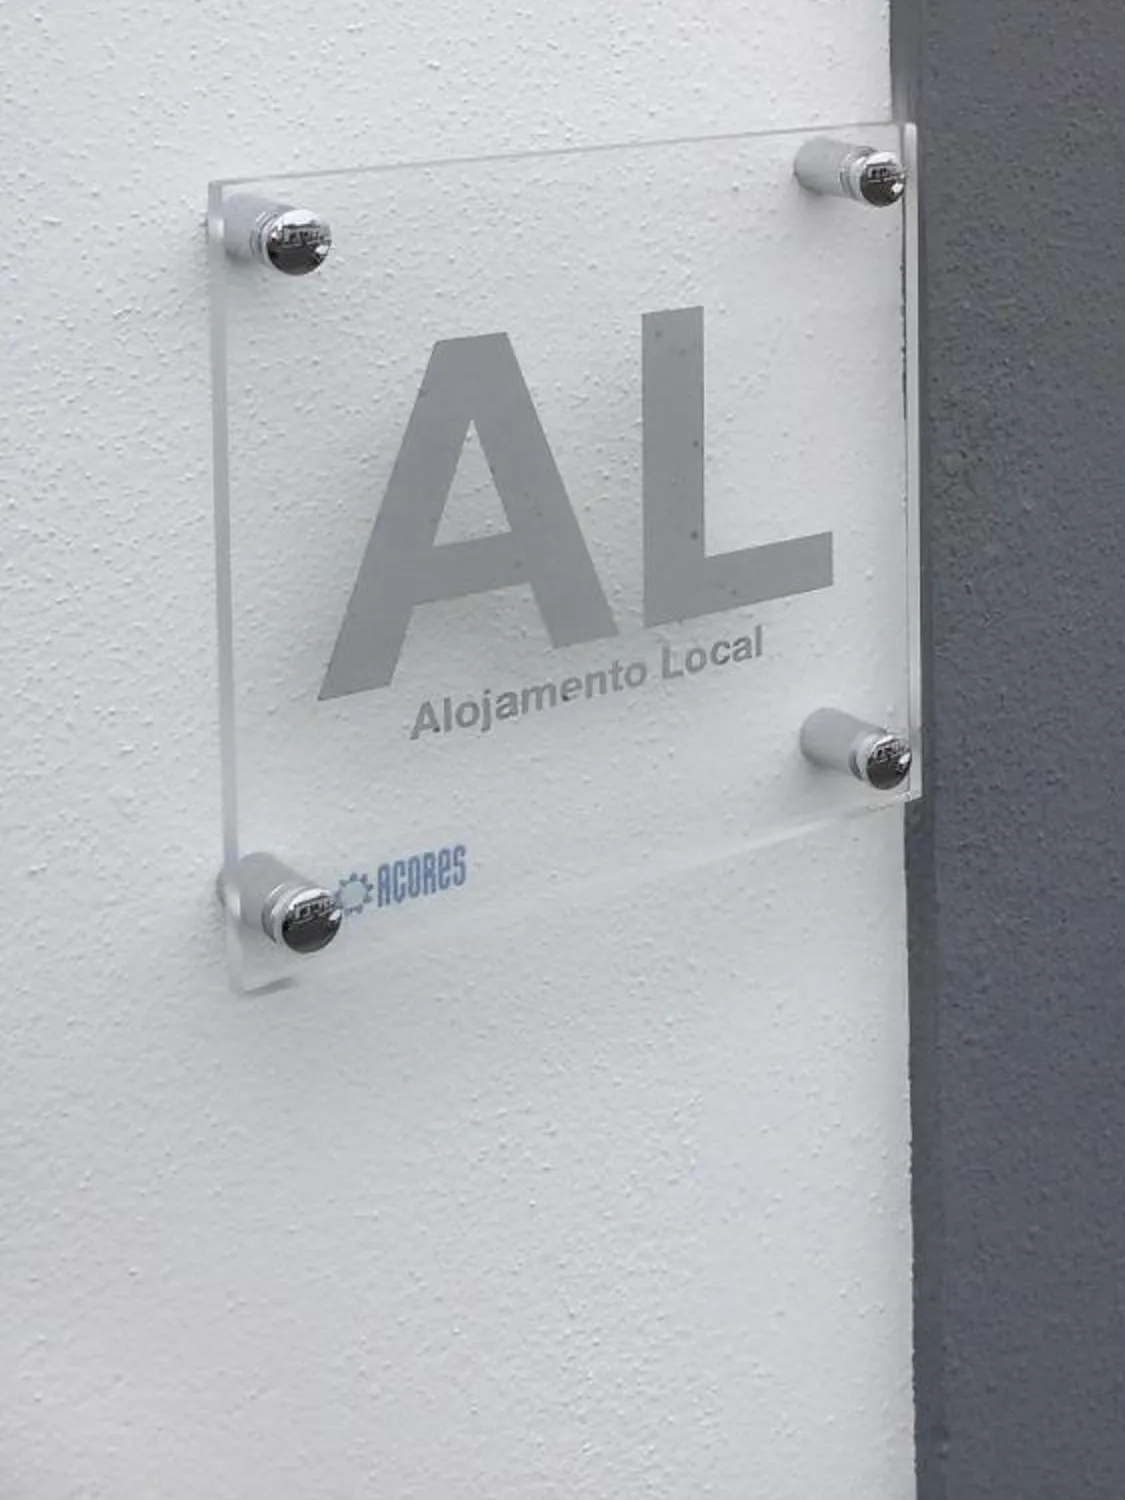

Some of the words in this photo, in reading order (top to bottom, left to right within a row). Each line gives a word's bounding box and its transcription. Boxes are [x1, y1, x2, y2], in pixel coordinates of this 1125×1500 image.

[318, 306, 833, 700] AL
[410, 660, 647, 739] Alojamento
[660, 624, 764, 679] Local
